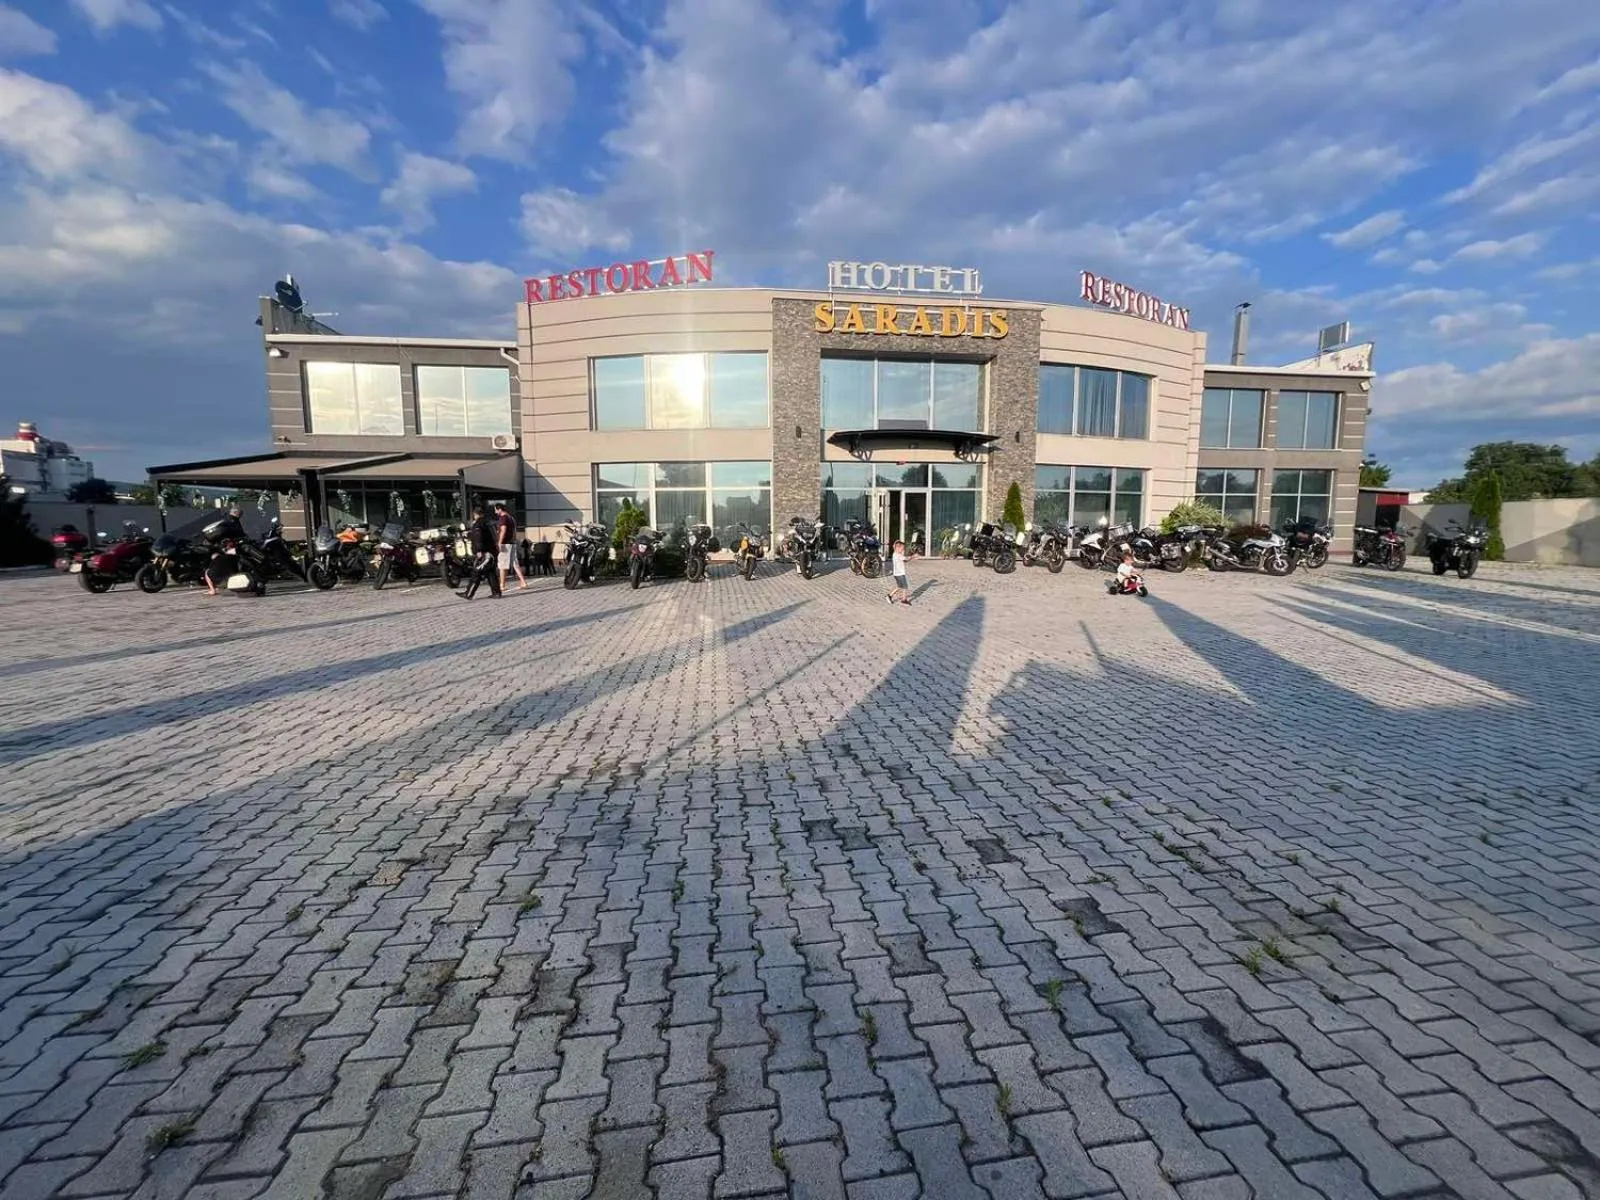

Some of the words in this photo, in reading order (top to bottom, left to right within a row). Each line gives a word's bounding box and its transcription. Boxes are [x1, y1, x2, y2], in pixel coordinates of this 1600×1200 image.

[524, 250, 714, 303] RESTORAN
[830, 260, 983, 294] HOTEL
[814, 302, 1009, 339] SARADIS
[1080, 270, 1190, 330] RESTORAN
